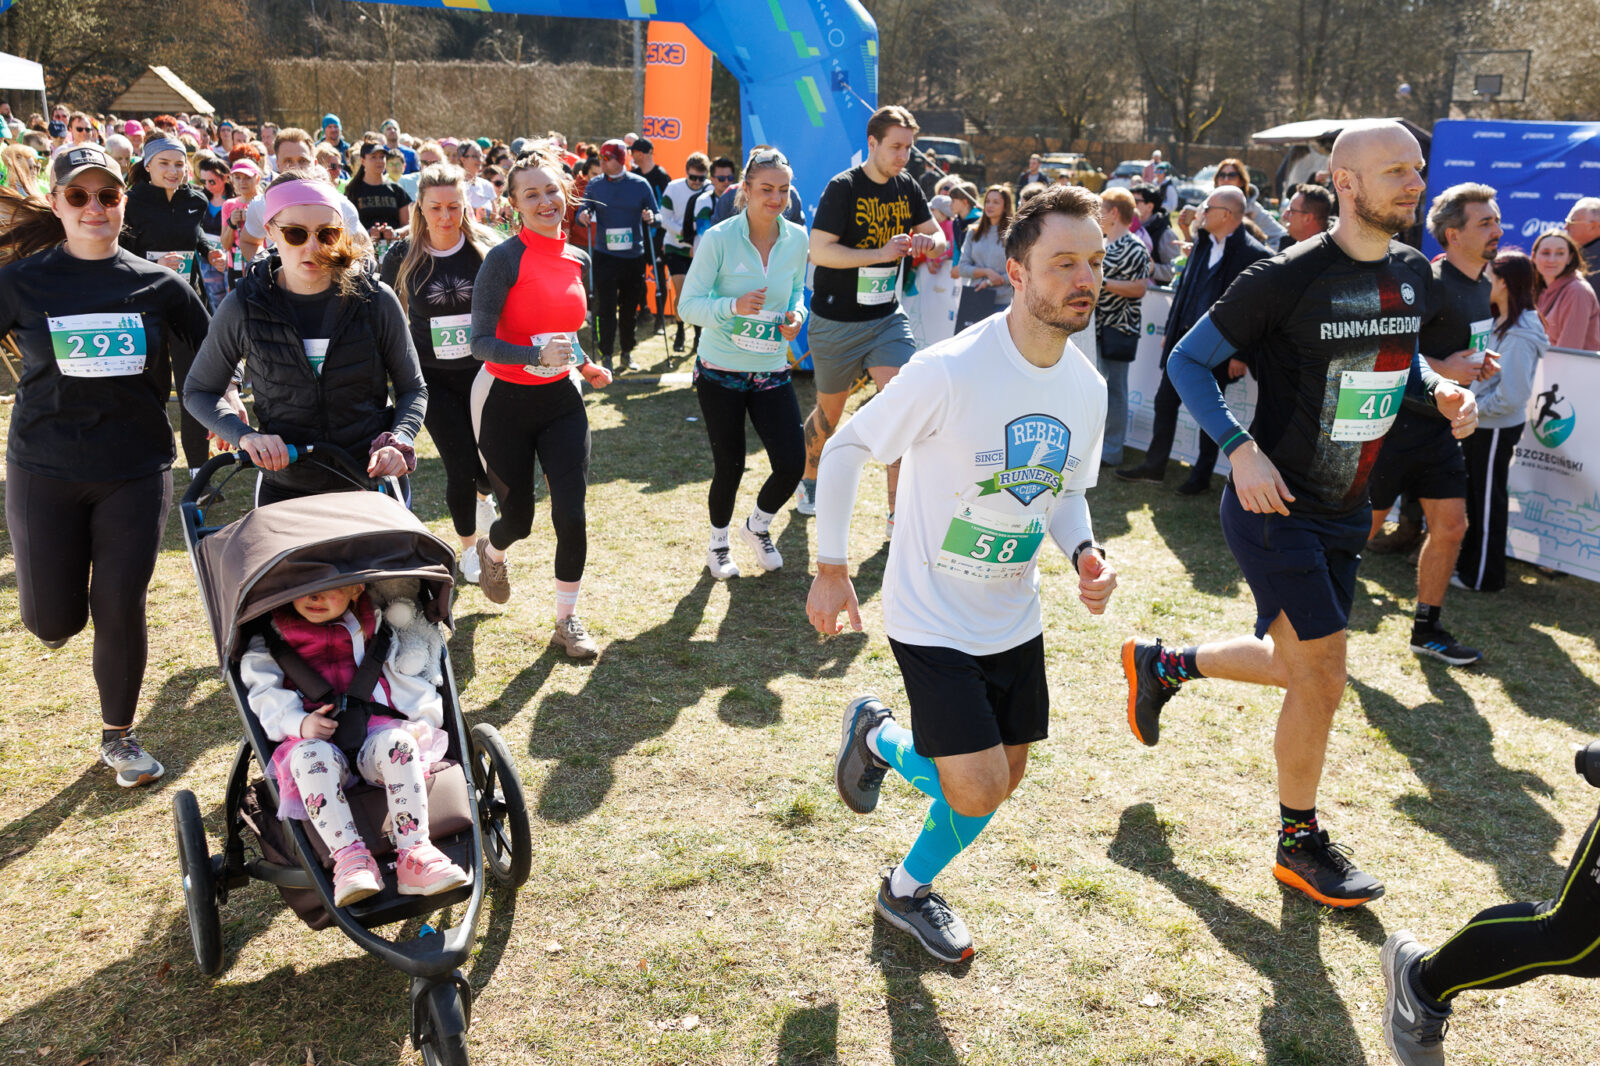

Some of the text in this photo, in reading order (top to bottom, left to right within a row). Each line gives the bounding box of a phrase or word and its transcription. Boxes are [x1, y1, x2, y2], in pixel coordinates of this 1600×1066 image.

[871, 279, 888, 293] 26
[740, 321, 776, 341] 291
[1320, 316, 1421, 340] RUNMAGEDDON
[67, 333, 136, 358] 293
[1359, 394, 1393, 419] 40
[1011, 421, 1065, 450] REBEL
[975, 452, 1004, 463] SINCE
[999, 468, 1060, 487] RUNNERS
[970, 533, 1018, 563] 58
